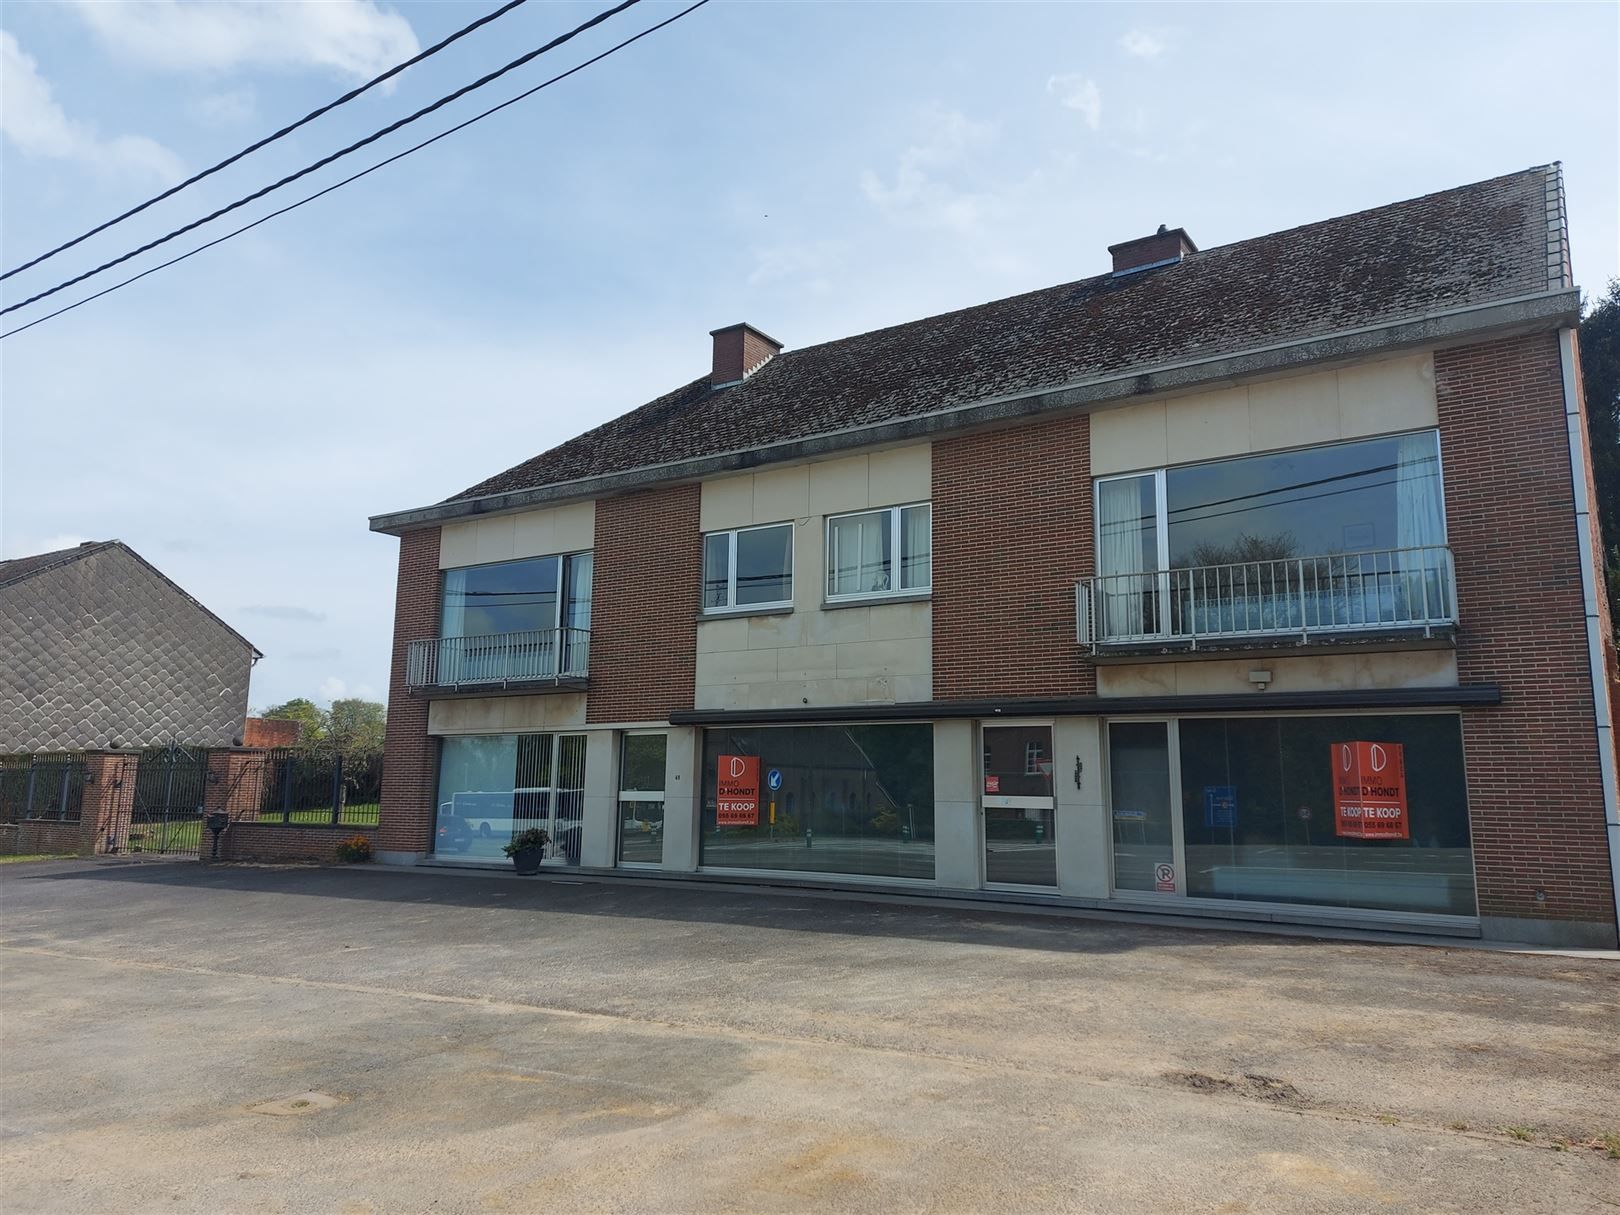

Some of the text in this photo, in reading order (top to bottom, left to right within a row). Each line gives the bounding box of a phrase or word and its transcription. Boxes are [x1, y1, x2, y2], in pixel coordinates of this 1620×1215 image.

[718, 802, 755, 811] TE KOOP
[1340, 806, 1361, 818] TE KOOP
[1363, 807, 1401, 819] TE KOOP
